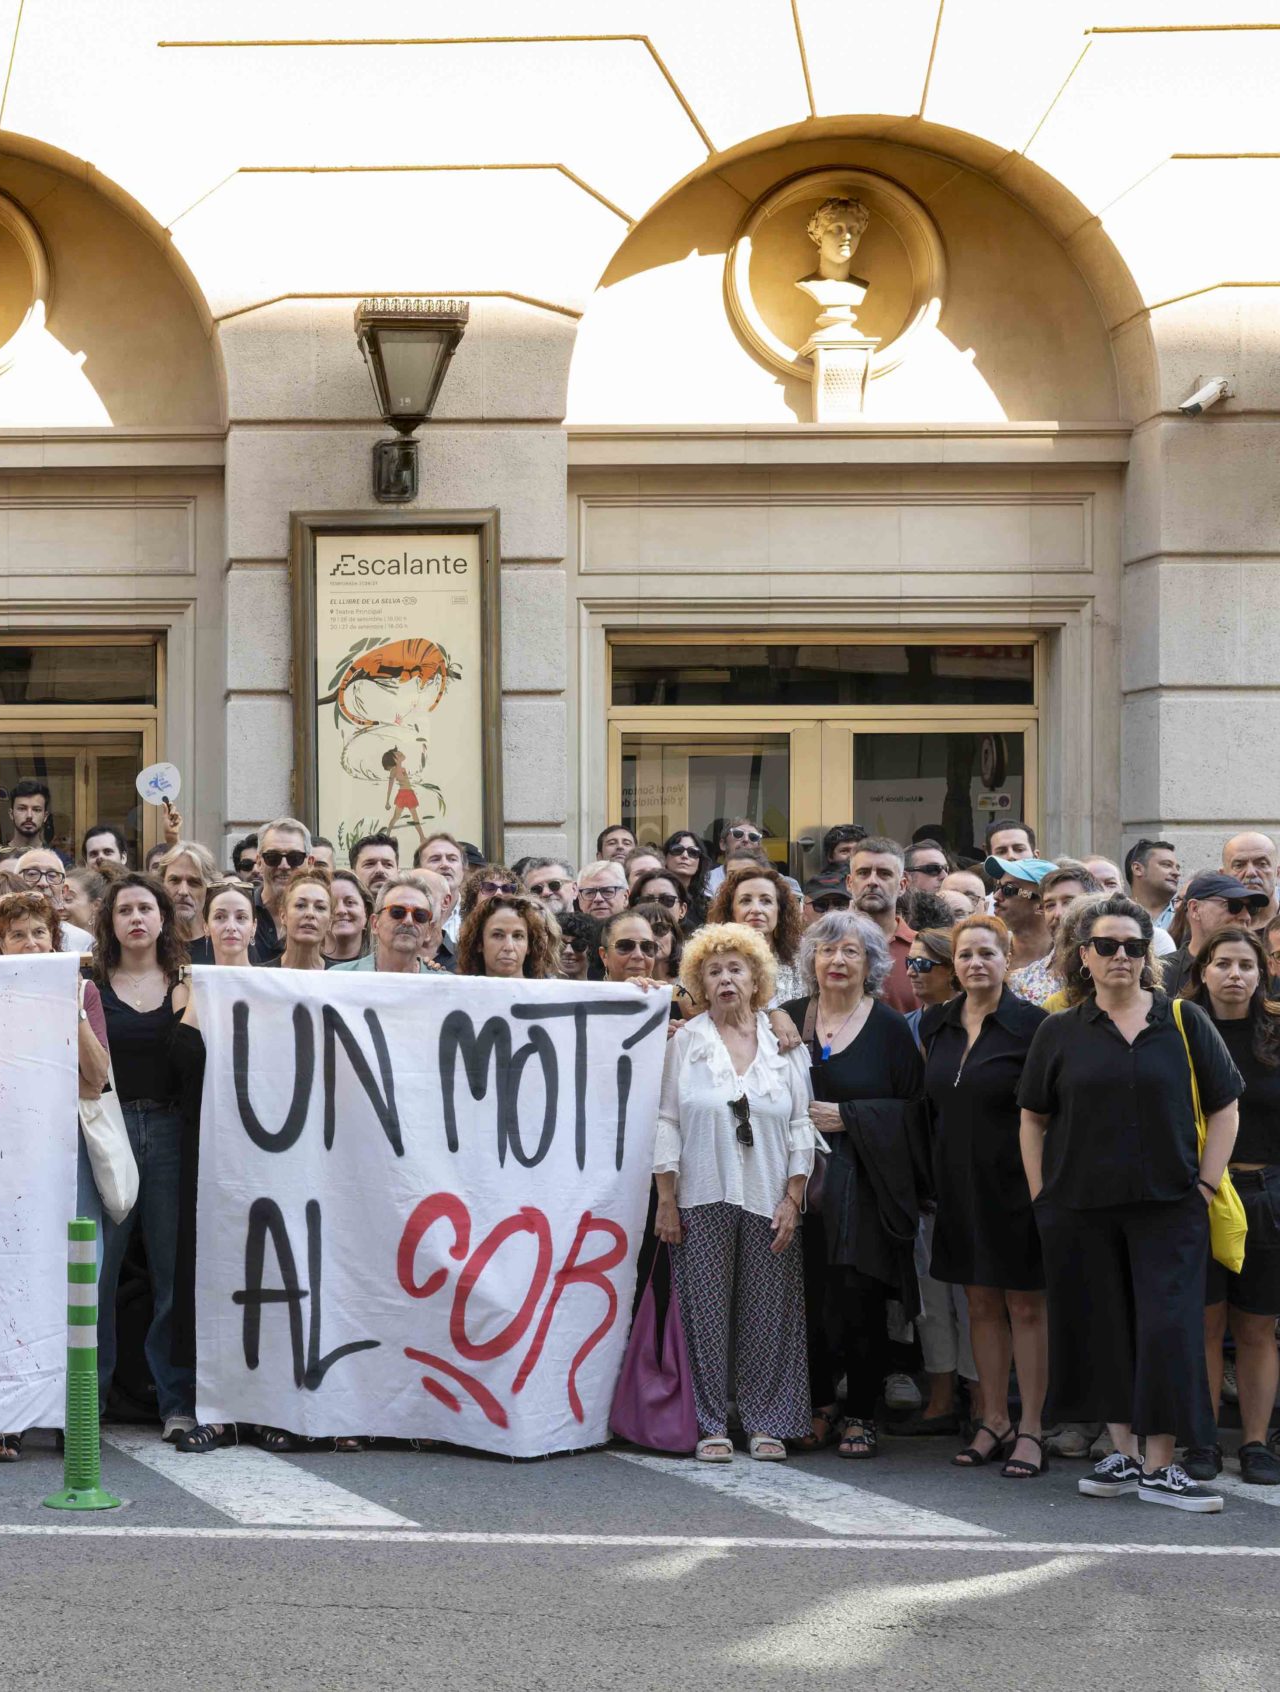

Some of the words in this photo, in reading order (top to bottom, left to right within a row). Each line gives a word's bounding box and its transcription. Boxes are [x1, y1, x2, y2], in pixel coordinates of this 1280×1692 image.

[232, 1000, 404, 1158] UN
[232, 1197, 380, 1391] AL
[397, 1192, 629, 1425] COR
